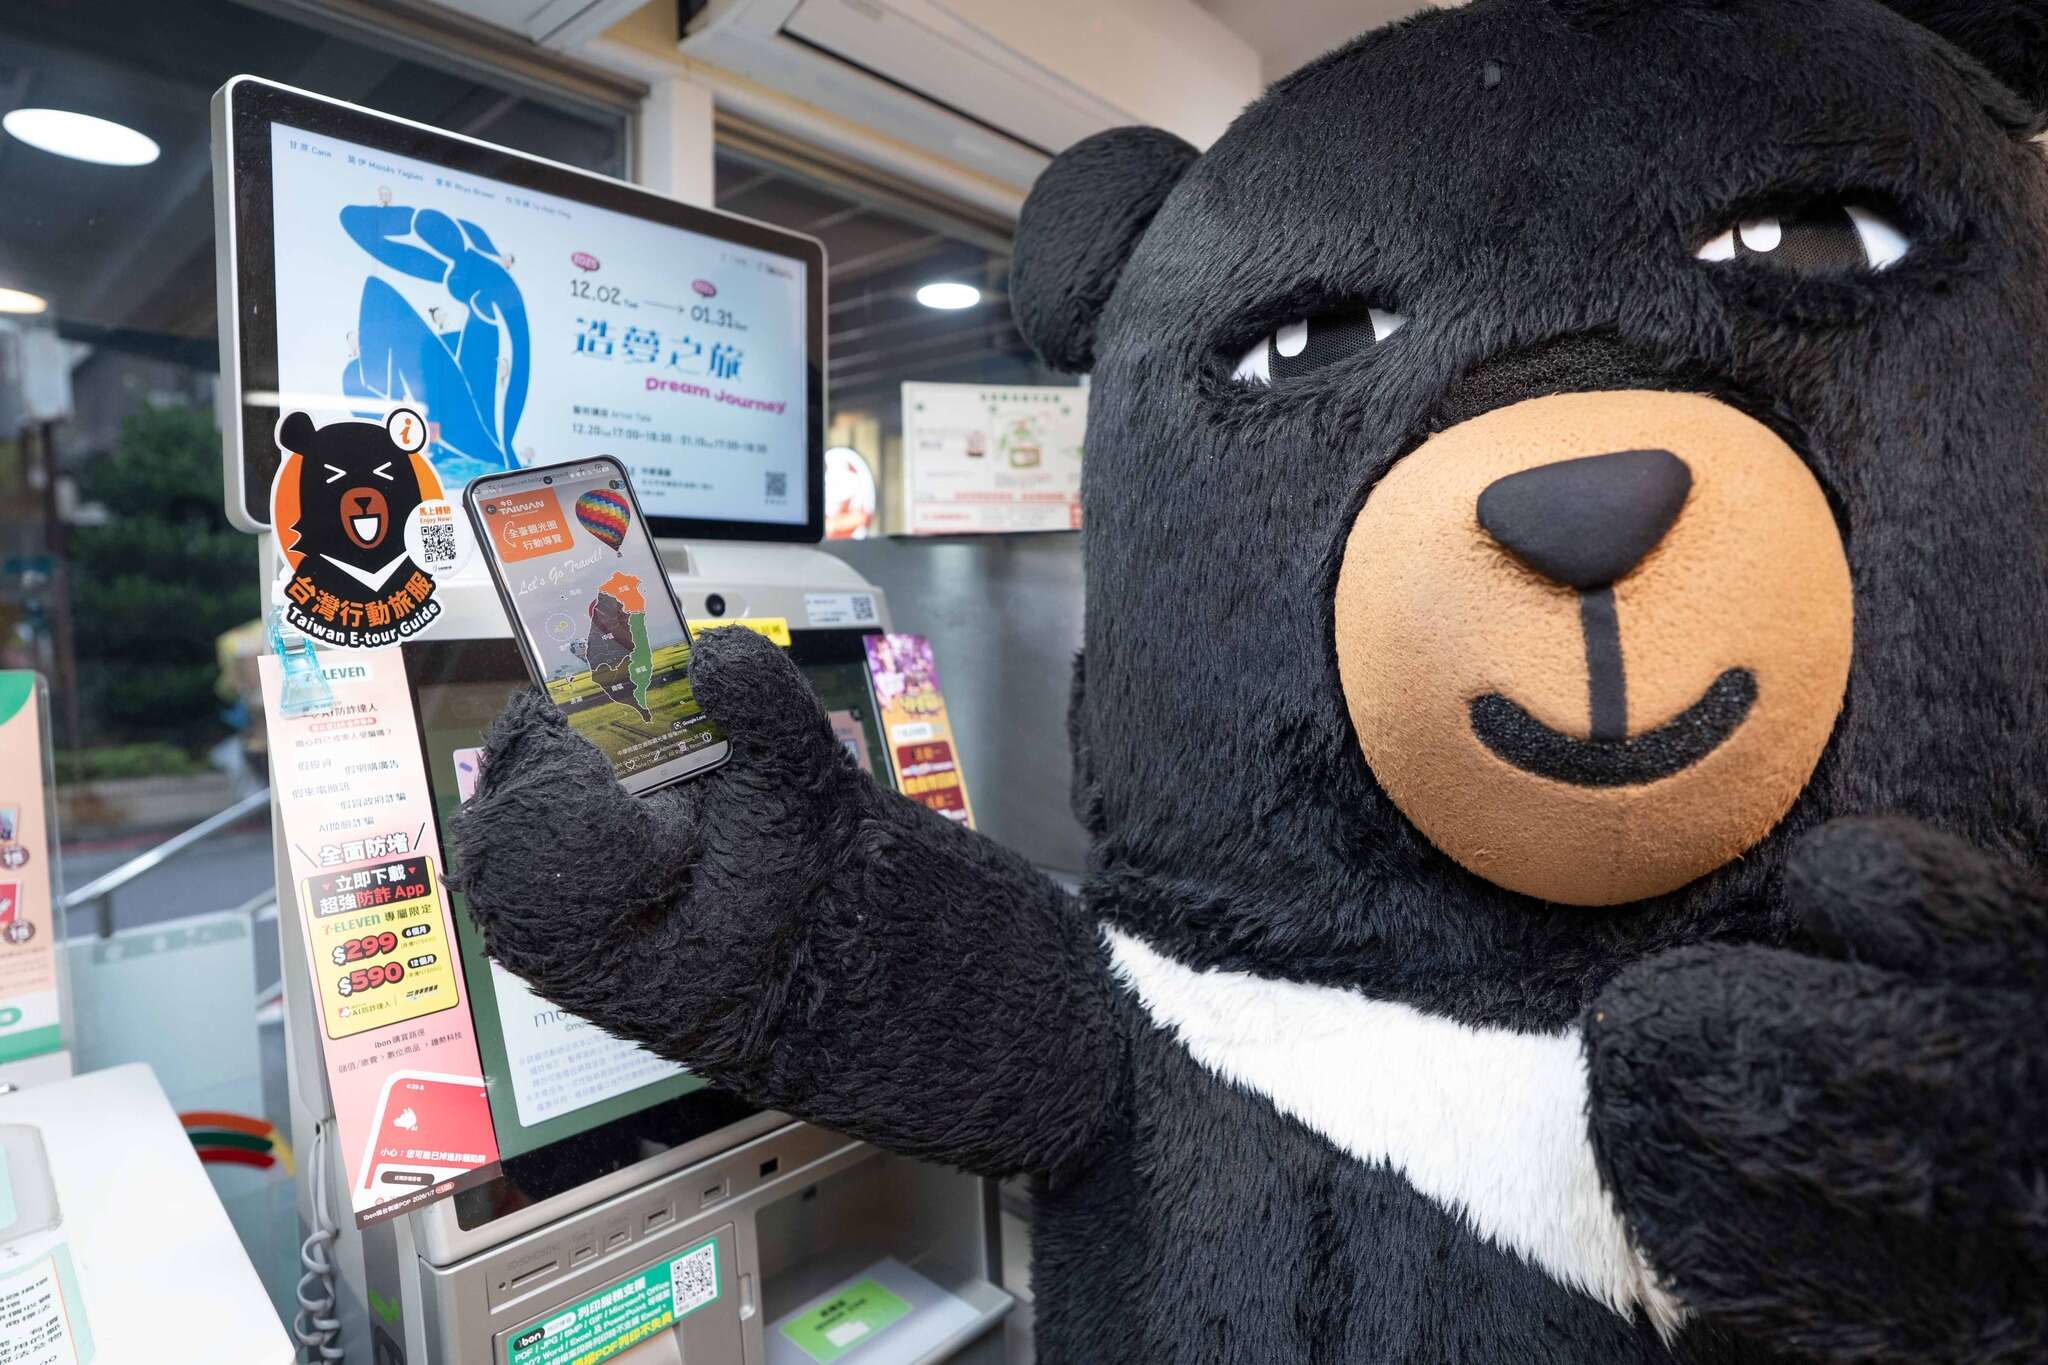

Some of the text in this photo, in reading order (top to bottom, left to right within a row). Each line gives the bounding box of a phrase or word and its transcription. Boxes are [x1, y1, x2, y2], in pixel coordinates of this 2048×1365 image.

[570, 279, 621, 306] 12.02
[690, 305, 733, 329] 01.31
[574, 317, 744, 381] 造夢之旅
[645, 377, 787, 414] Dream Journey
[498, 500, 545, 515] TAIWAN
[518, 575, 545, 596] Let's
[549, 565, 565, 585] Go
[286, 570, 434, 628] 台灣行動旅服
[287, 602, 439, 647] Taiwan E-tour Guide
[319, 832, 410, 866] 全面防堵
[336, 864, 407, 892] 立即下載
[319, 883, 426, 916] 超強防詐 App
[384, 903, 433, 923] 專屬限定
[332, 931, 399, 967] $299
[337, 961, 405, 997] $590
[374, 1038, 392, 1049] ibon
[515, 1347, 533, 1364] PDF
[540, 1336, 558, 1351] JPG
[542, 1344, 564, 1360] Word
